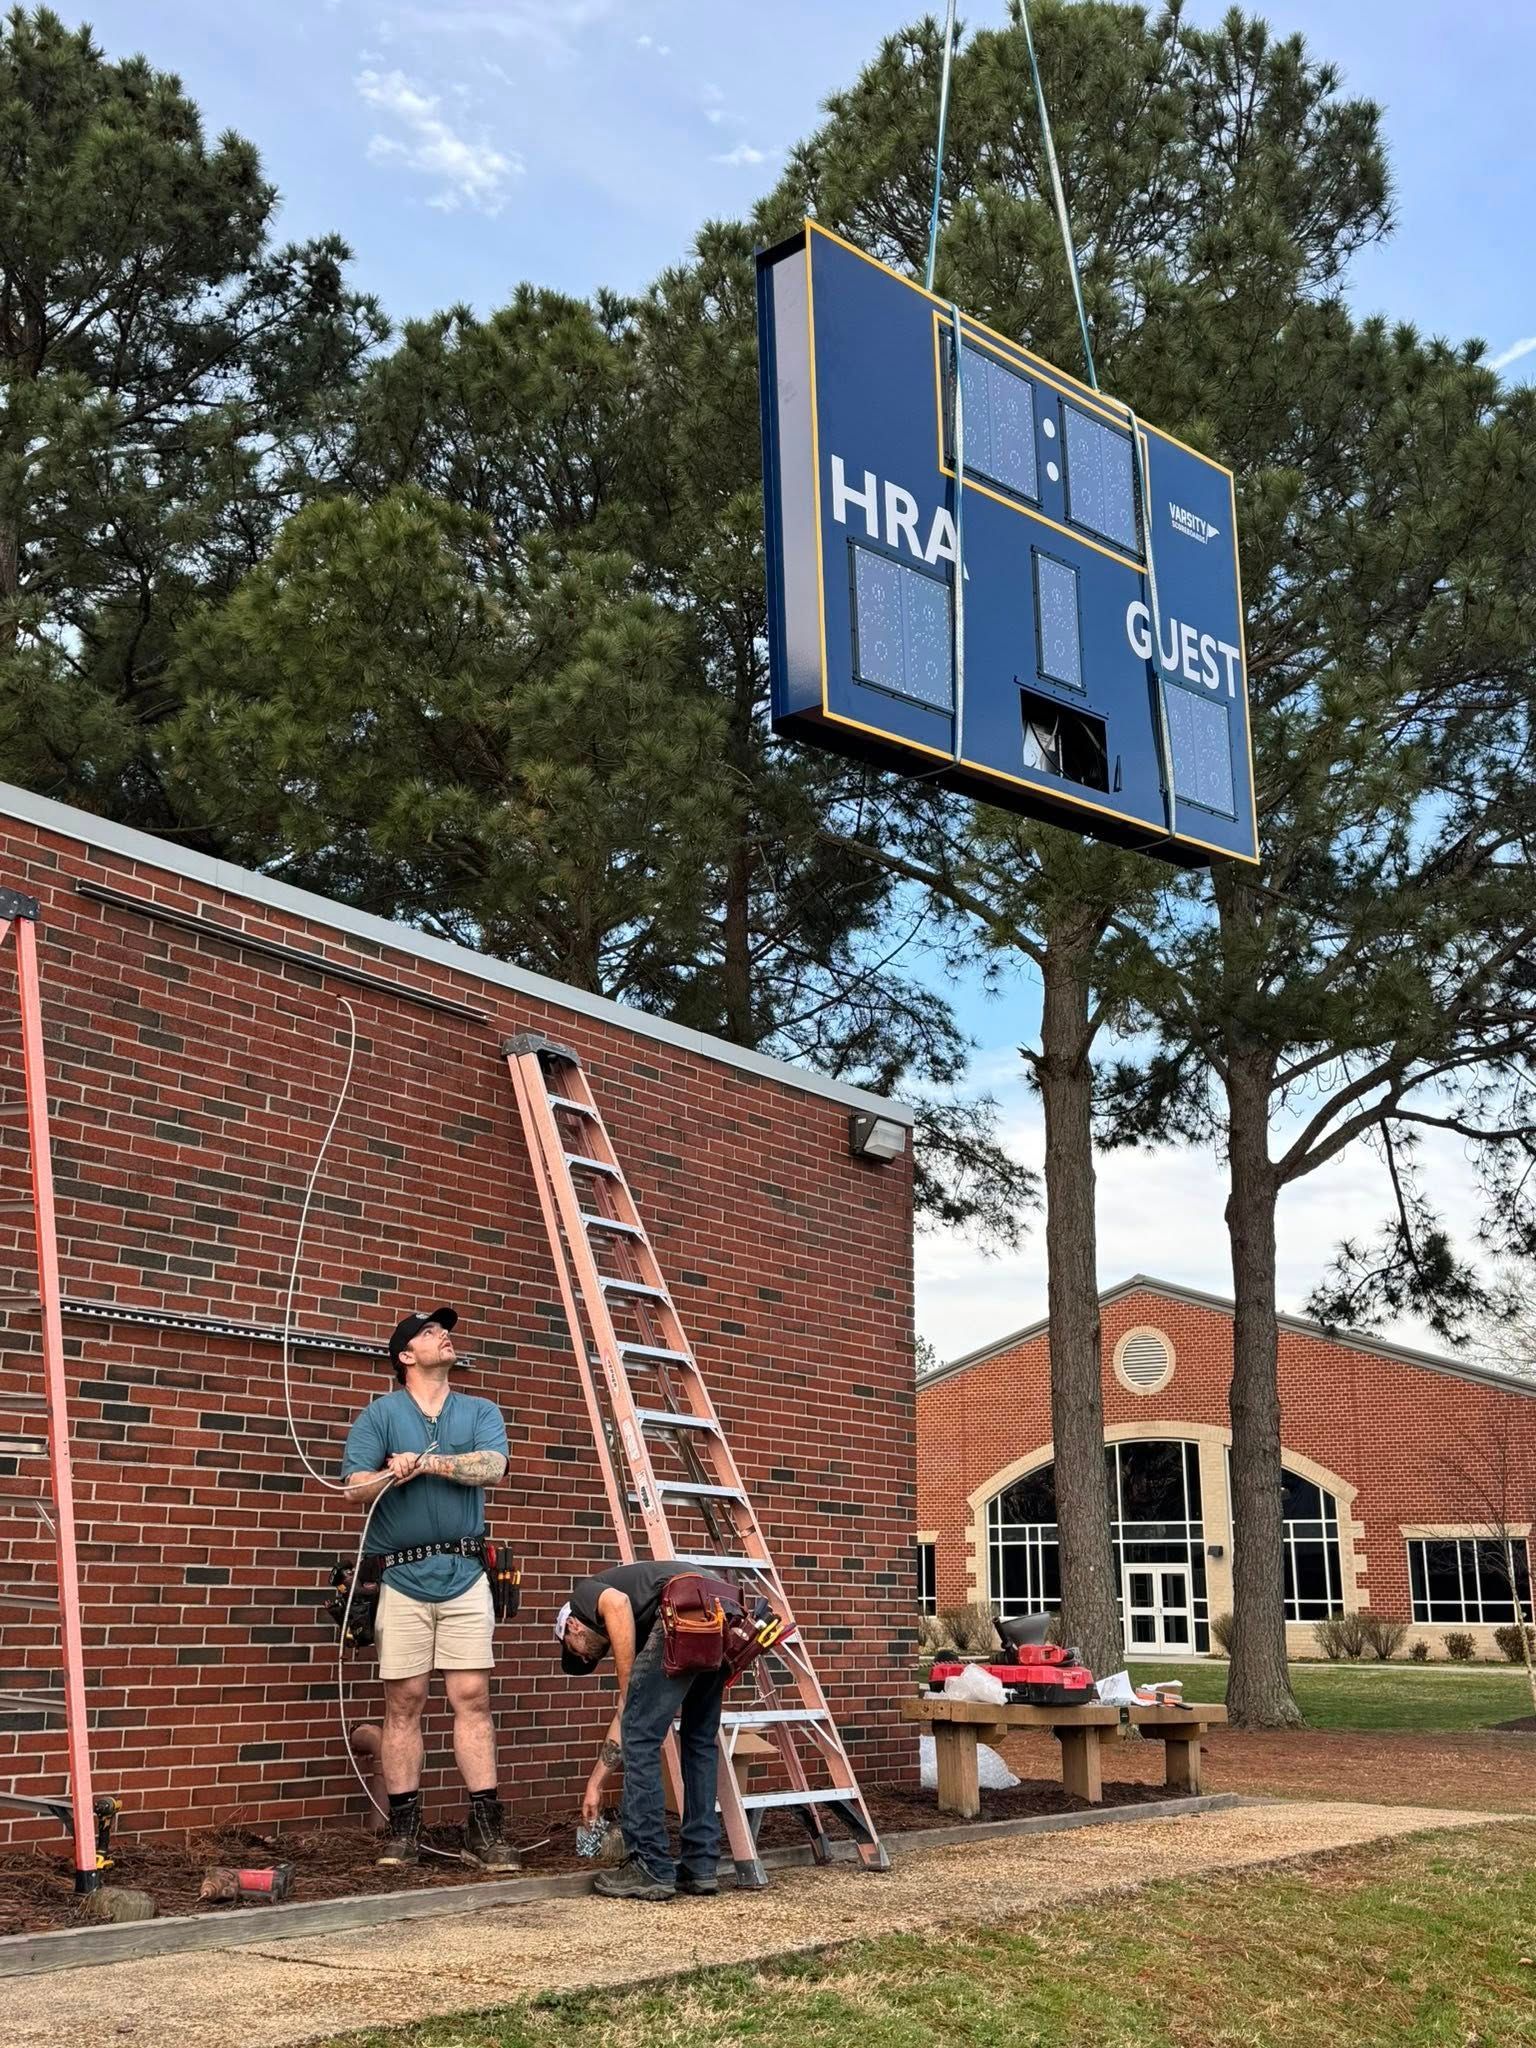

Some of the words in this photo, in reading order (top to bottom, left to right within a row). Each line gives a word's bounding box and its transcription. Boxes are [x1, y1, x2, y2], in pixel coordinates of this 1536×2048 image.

[831, 454, 970, 581] HRA
[1168, 501, 1207, 537] VARSITY
[1126, 600, 1240, 698] GUEST
